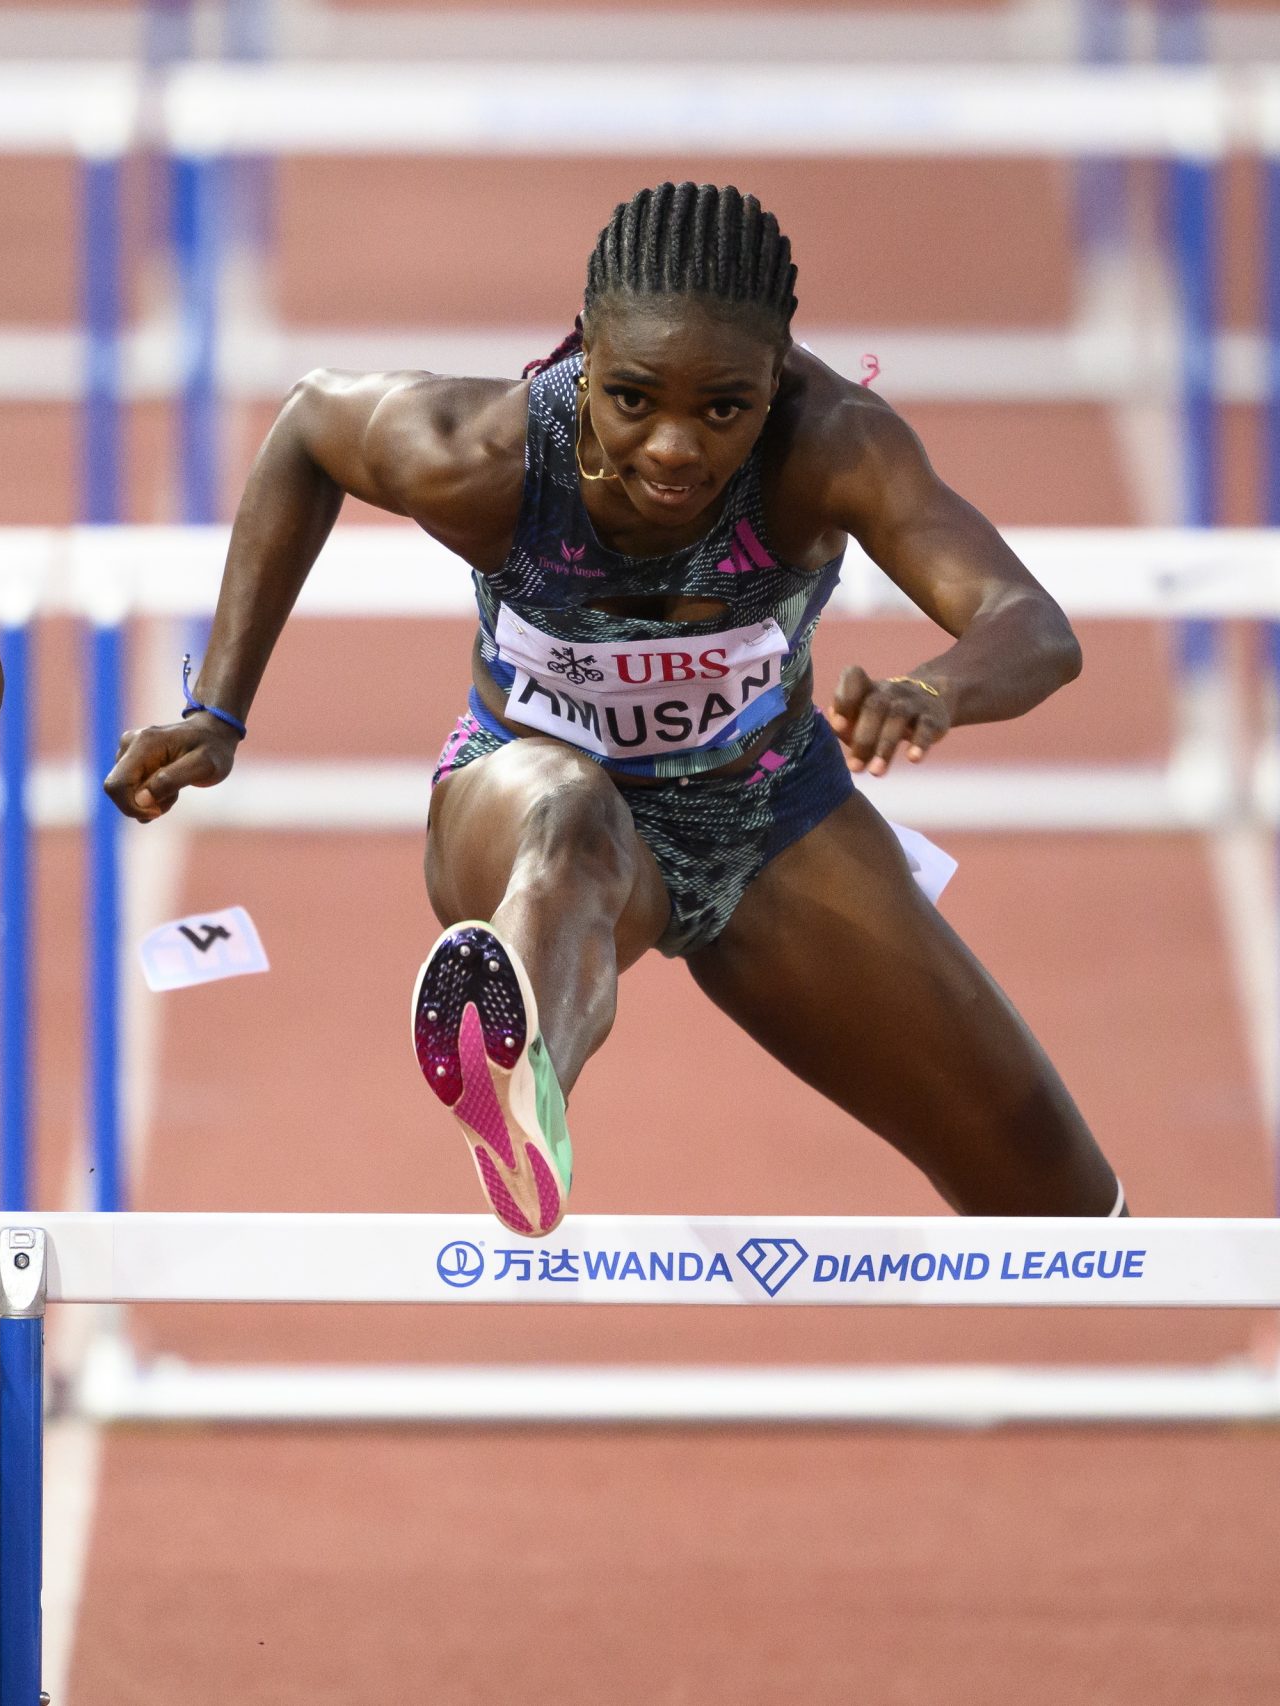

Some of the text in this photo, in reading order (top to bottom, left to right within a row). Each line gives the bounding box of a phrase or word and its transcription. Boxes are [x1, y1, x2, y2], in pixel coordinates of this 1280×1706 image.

[573, 564, 607, 578] Angels
[610, 648, 731, 684] UBS
[517, 659, 771, 748] AMUSAN
[178, 924, 232, 953] 4
[493, 1248, 578, 1282] 万达
[582, 1249, 1147, 1282] WANDA DIAMOND LEAGUE
